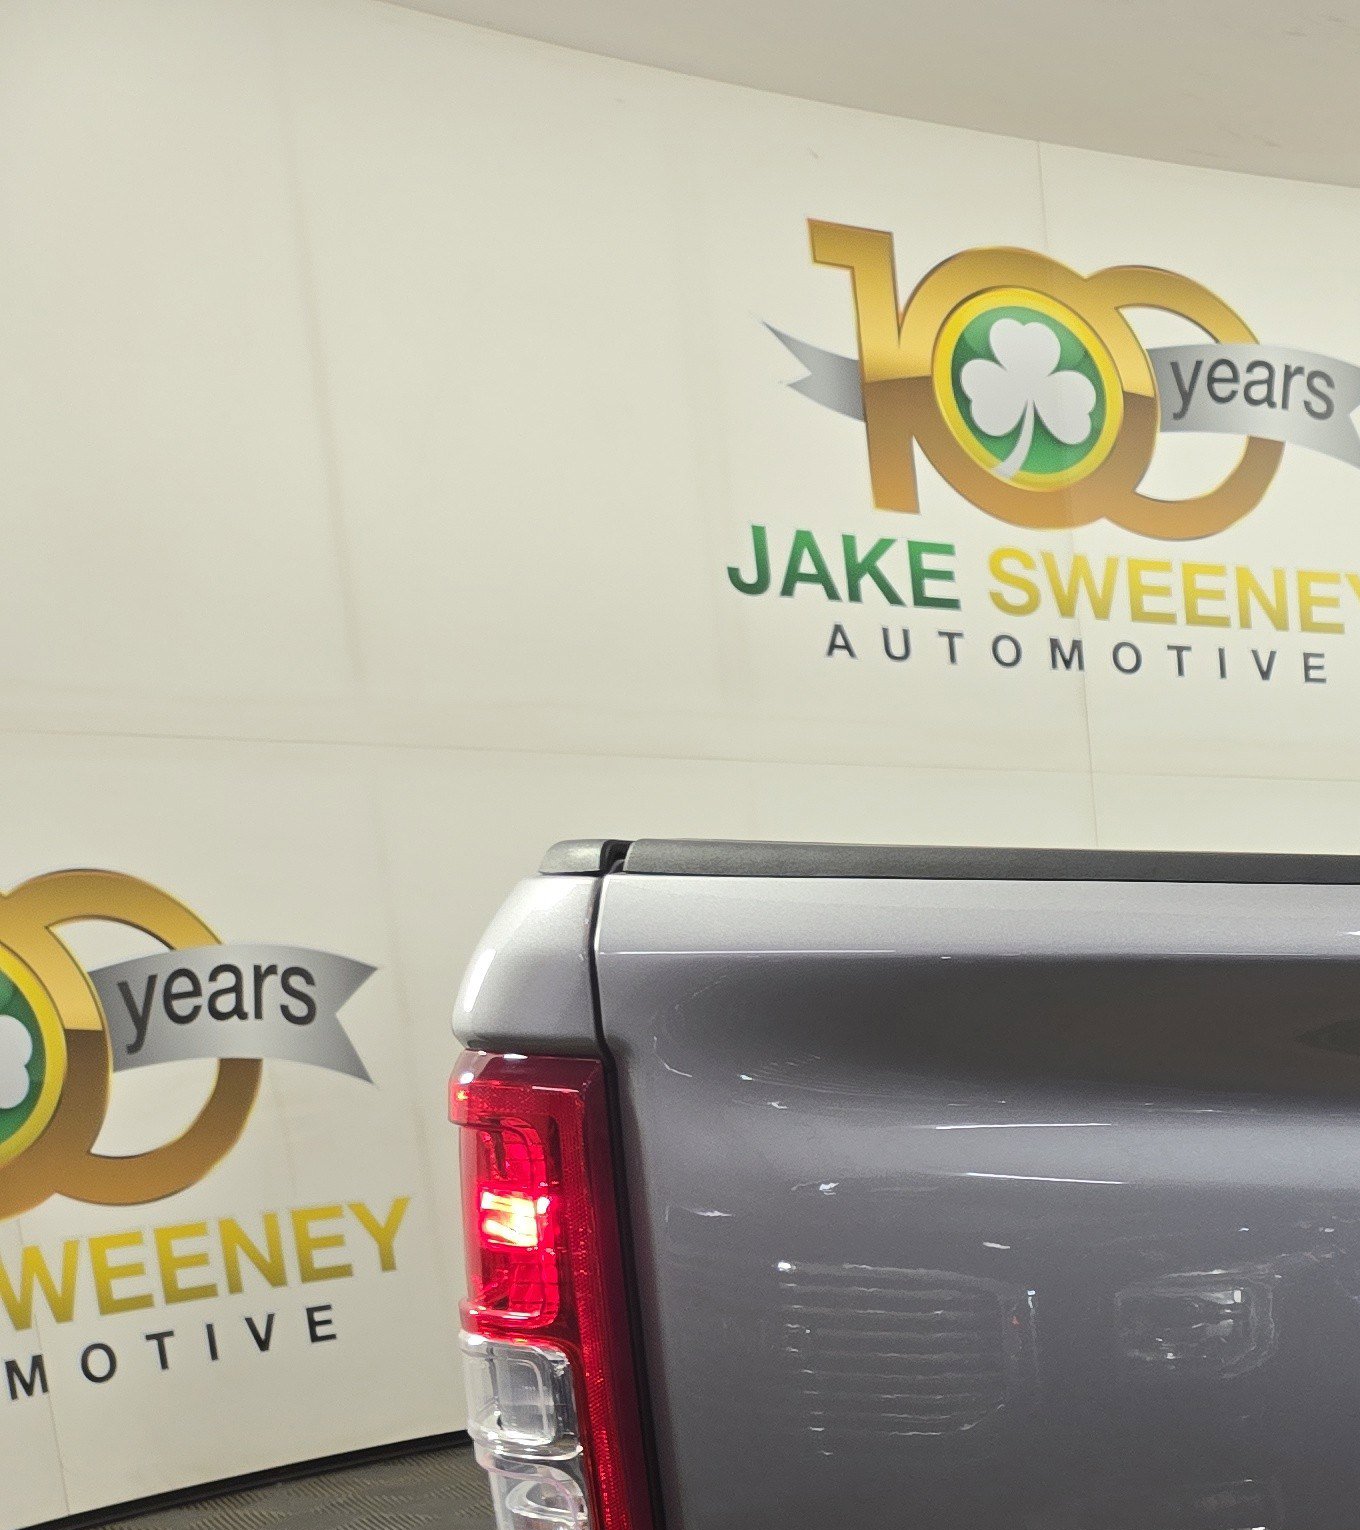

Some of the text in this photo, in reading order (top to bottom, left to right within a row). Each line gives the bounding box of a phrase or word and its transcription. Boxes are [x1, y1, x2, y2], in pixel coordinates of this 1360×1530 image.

[807, 218, 1336, 541] 100 years
[727, 524, 962, 611] JAKE
[826, 623, 1328, 685] AUTOMOTIVE
[117, 962, 318, 1053] years
[5, 1304, 338, 1401] MOTIVE
